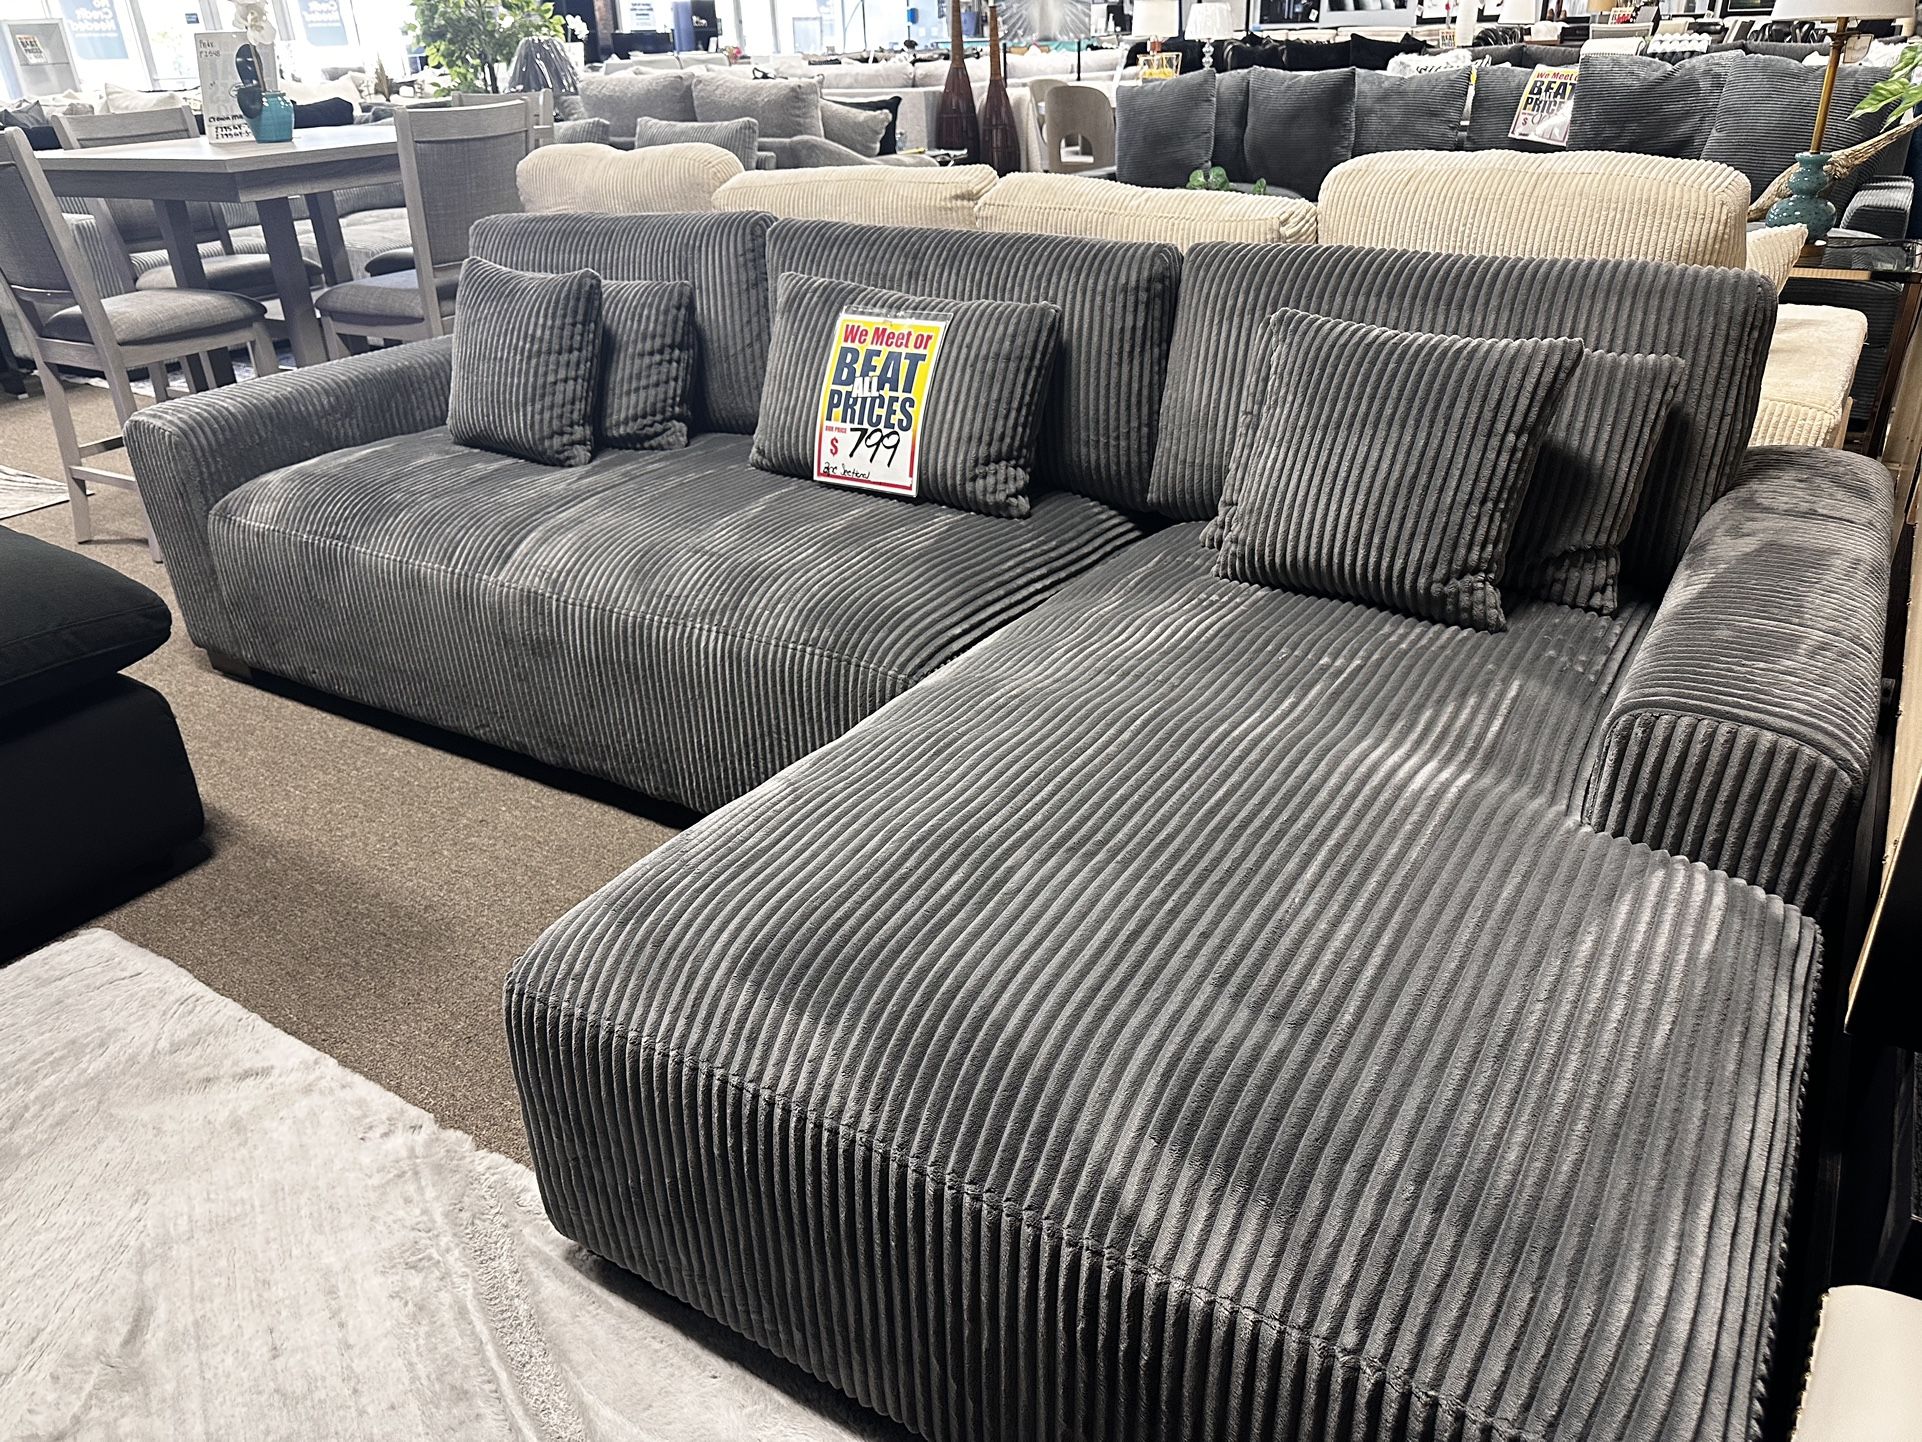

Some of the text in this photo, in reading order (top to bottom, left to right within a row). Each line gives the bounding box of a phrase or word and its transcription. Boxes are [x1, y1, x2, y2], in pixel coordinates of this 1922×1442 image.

[1551, 72, 1574, 80] Meet
[1528, 80, 1578, 100] BEAT
[843, 324, 933, 350] We Meet or
[832, 346, 927, 394] BEAT
[852, 375, 880, 397] ALL
[825, 388, 916, 432] PRICES
[830, 428, 900, 468] $ 799
